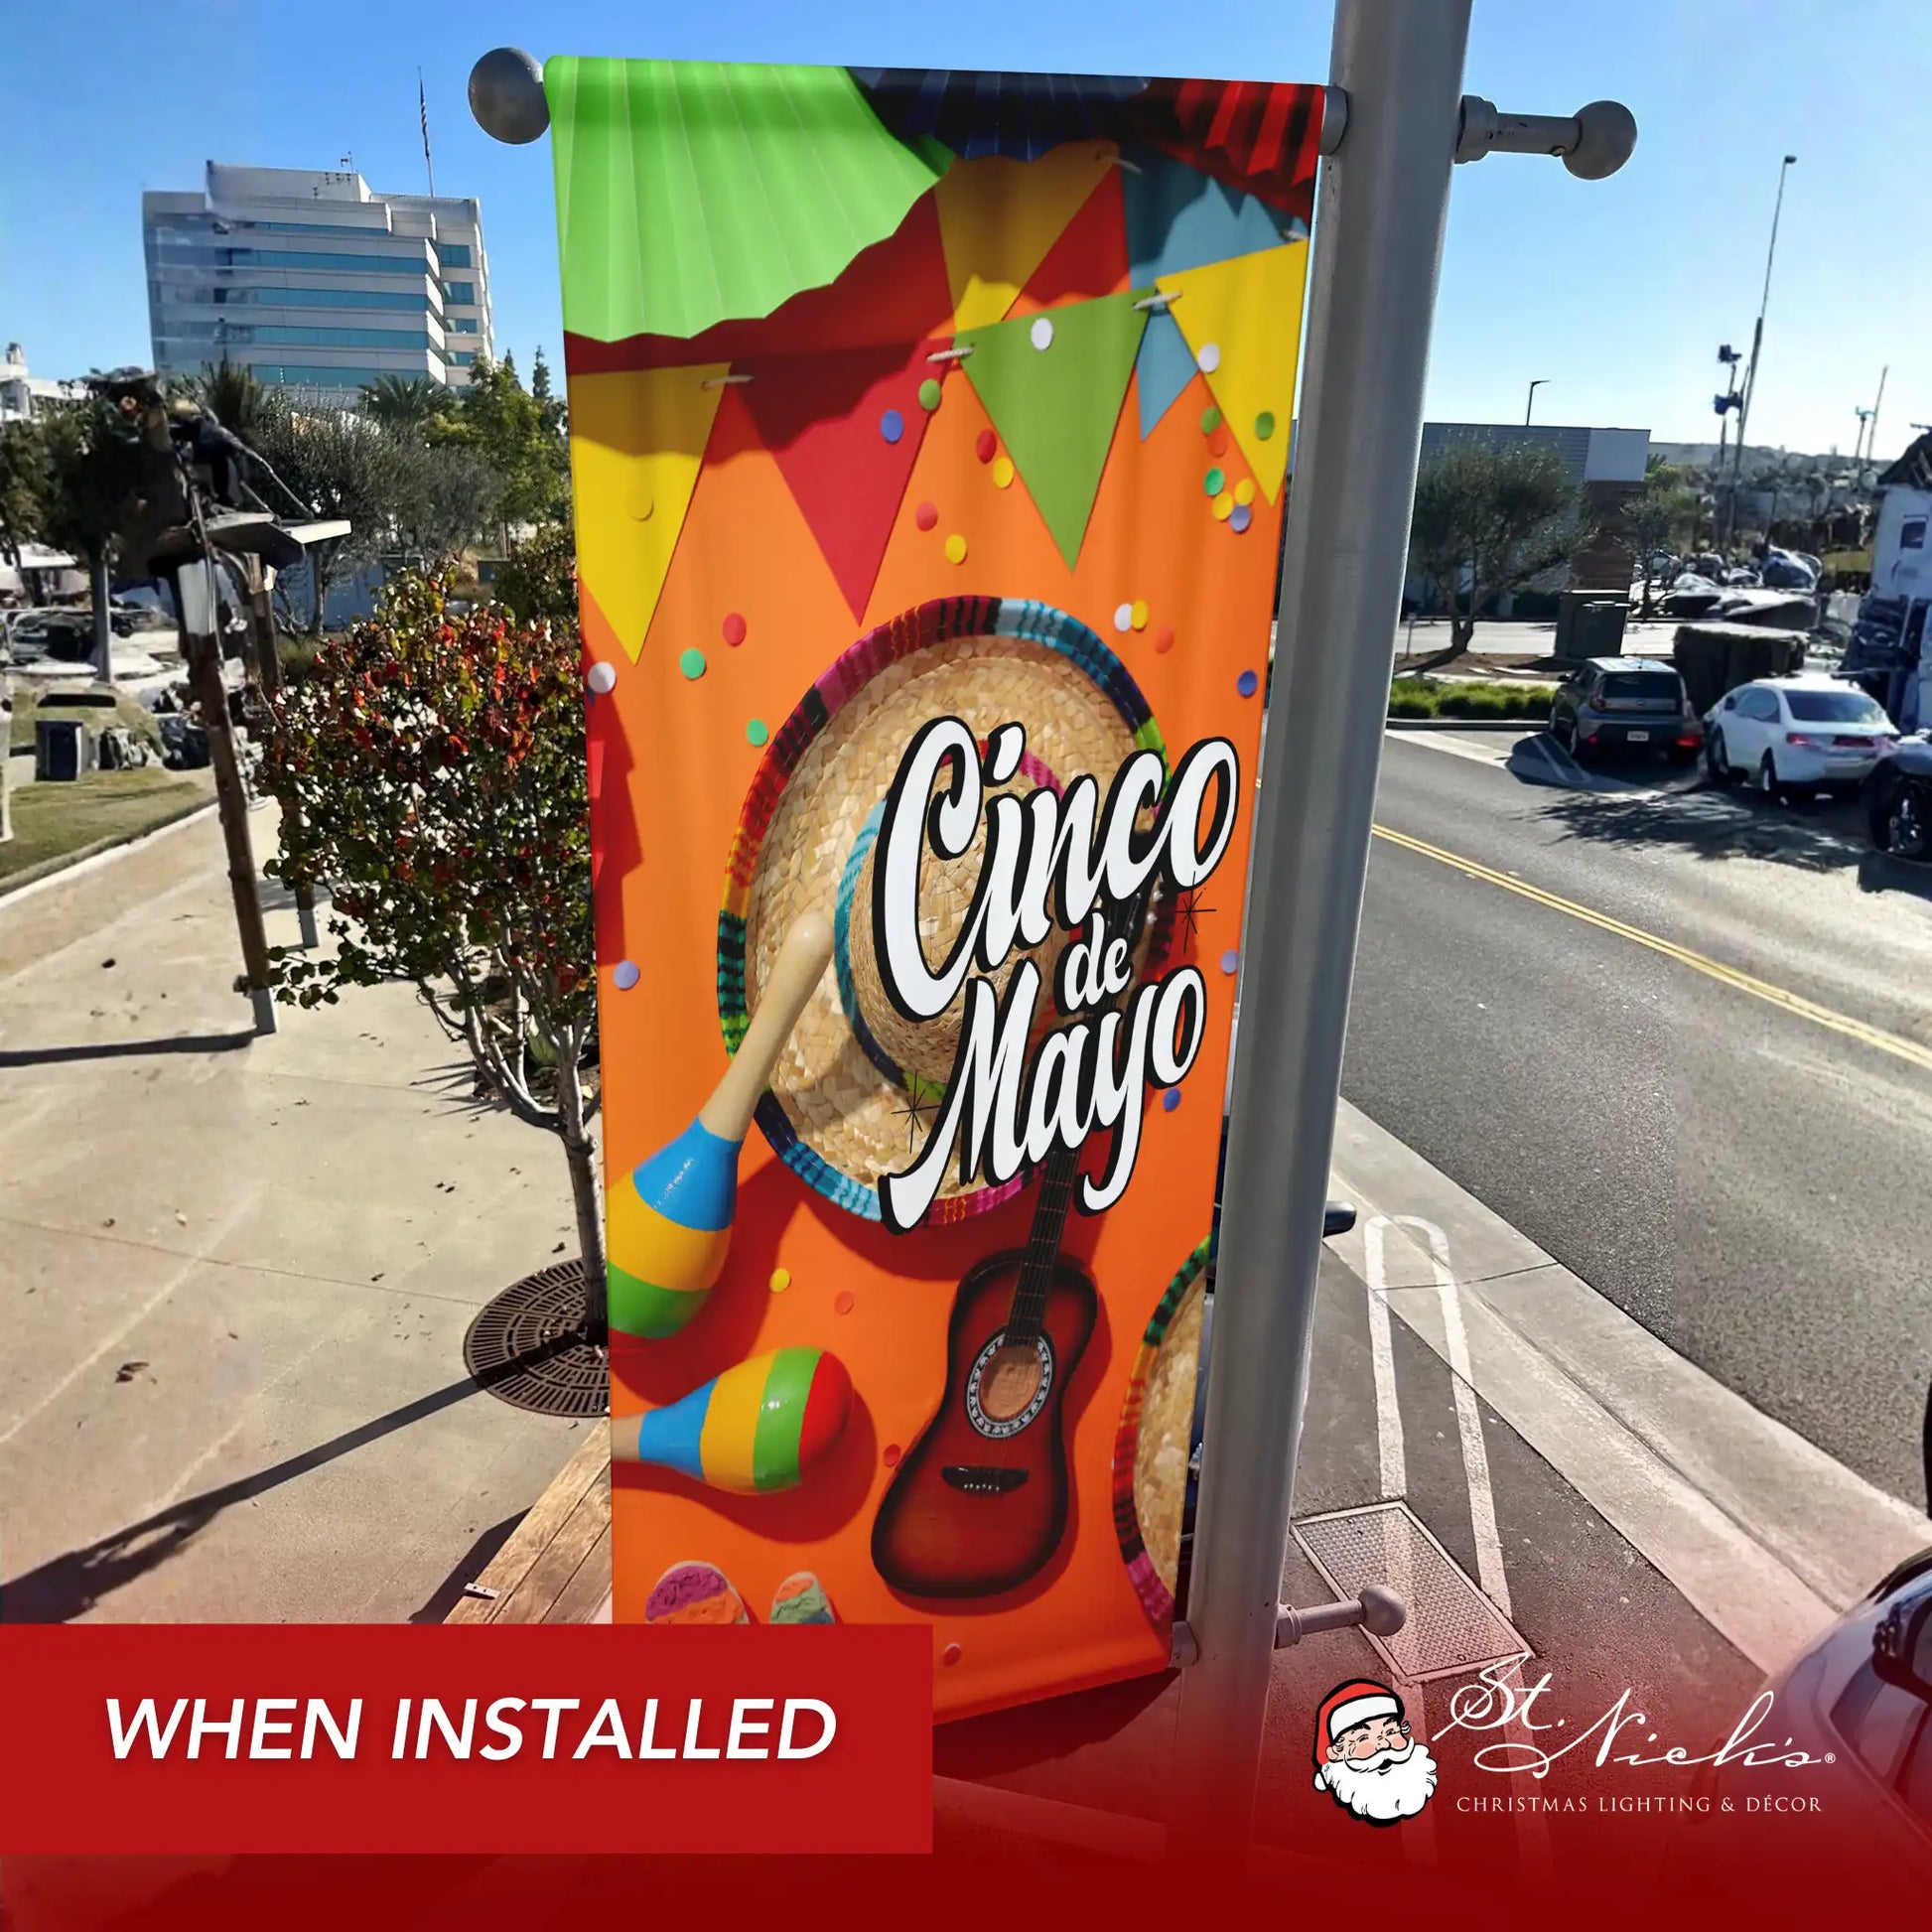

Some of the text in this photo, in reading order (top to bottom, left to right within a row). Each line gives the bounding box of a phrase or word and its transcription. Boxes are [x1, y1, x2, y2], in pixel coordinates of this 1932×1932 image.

[873, 715, 1239, 1022] Cinco
[1055, 907, 1132, 1016] de
[879, 956, 1207, 1234] Mayo
